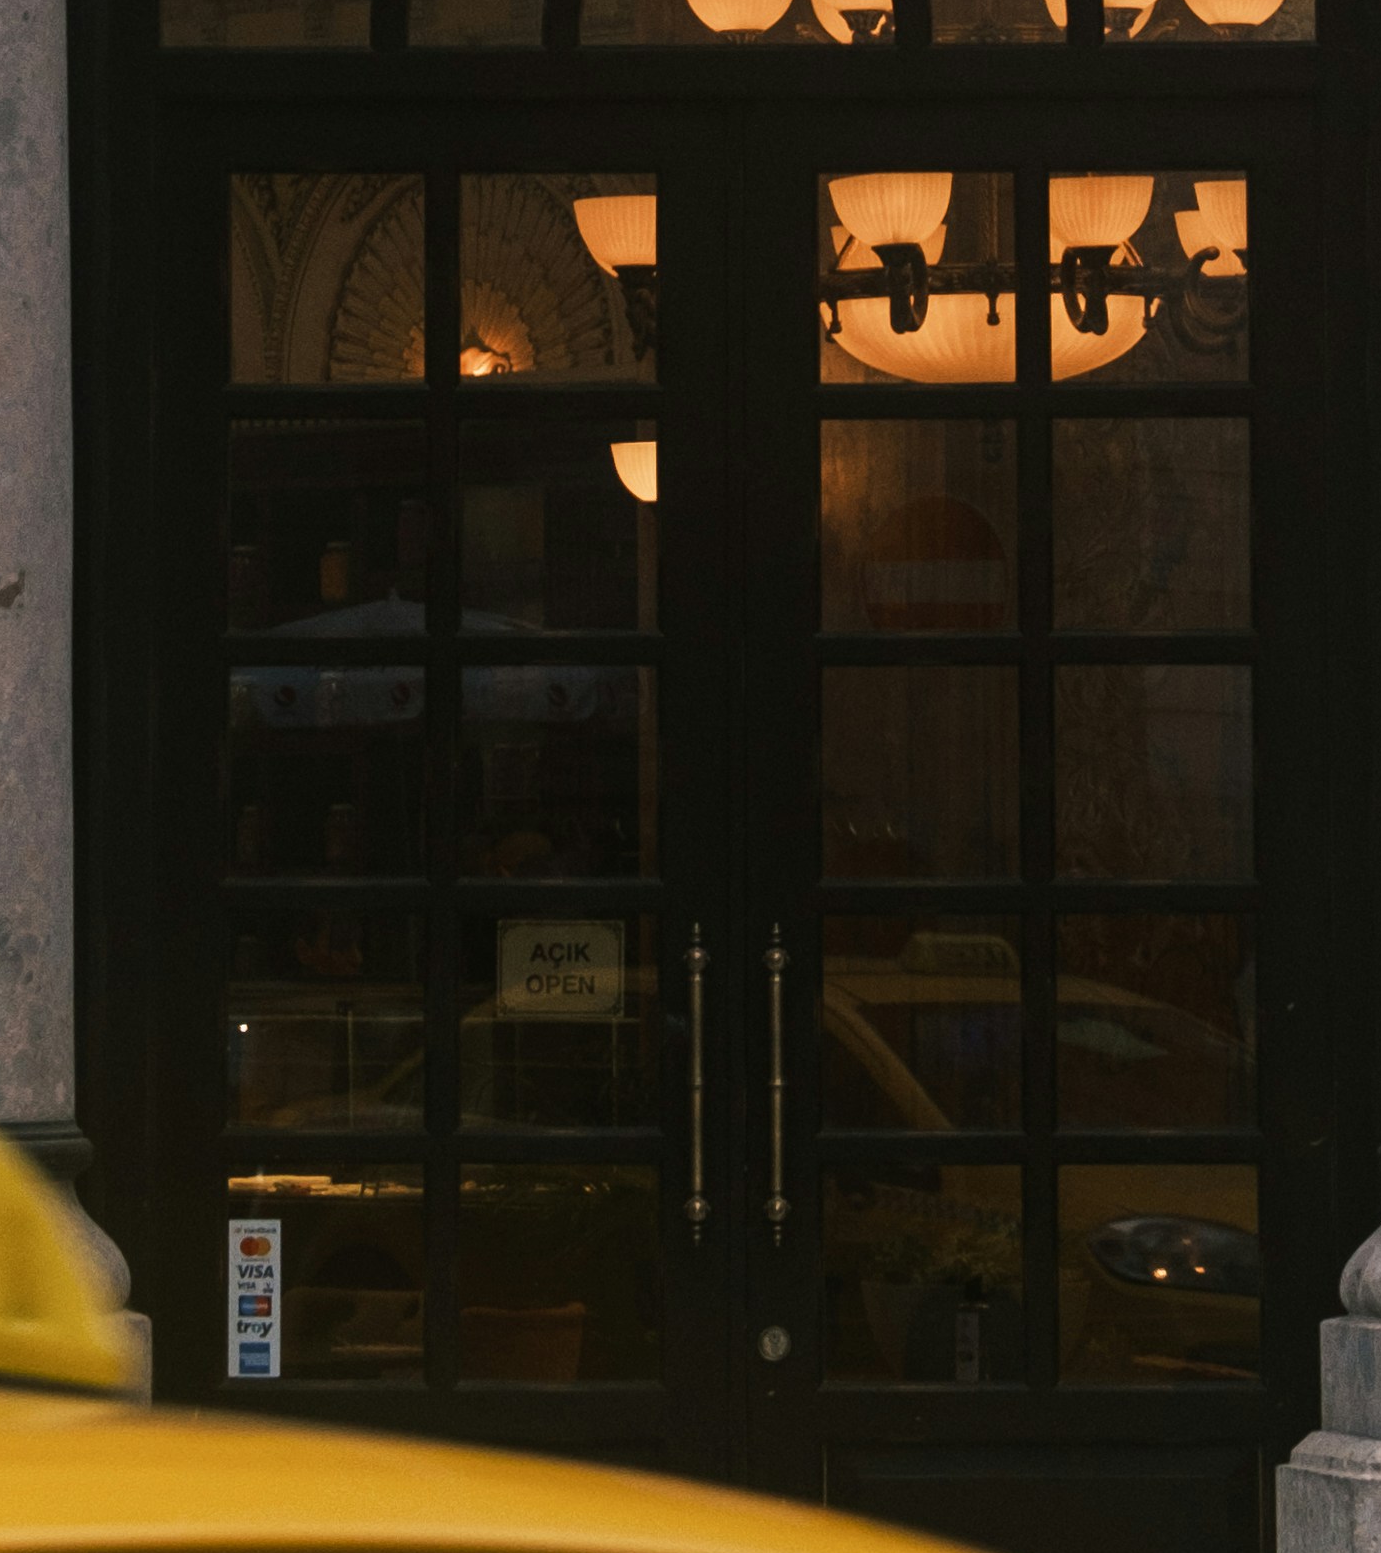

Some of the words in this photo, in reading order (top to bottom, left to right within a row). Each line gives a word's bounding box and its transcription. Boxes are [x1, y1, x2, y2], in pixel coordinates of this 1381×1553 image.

[530, 942, 591, 969] AÇIK
[525, 974, 596, 995] OPEN
[236, 1264, 274, 1279] VISA
[236, 1319, 272, 1338] troy
